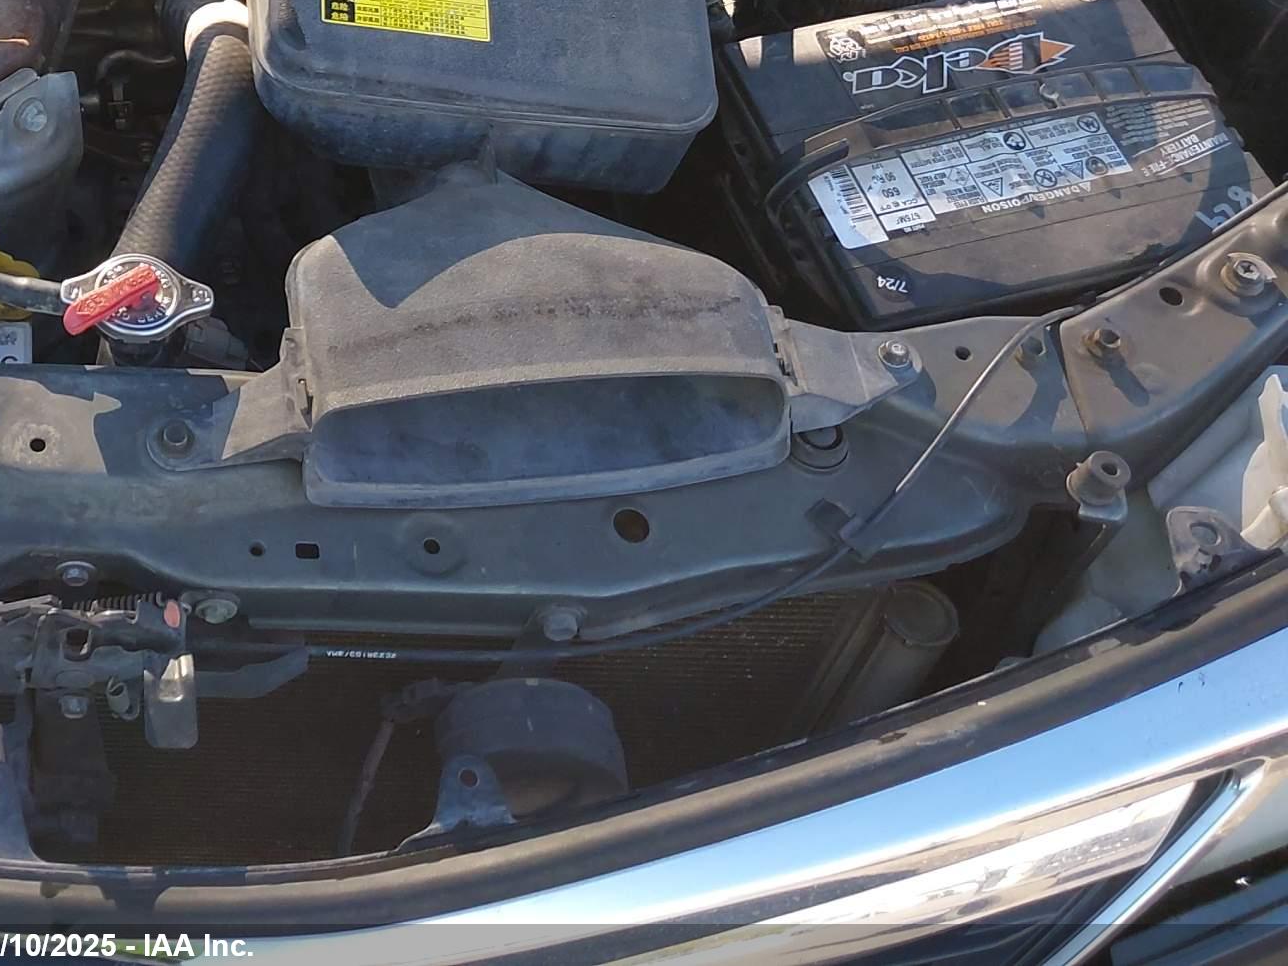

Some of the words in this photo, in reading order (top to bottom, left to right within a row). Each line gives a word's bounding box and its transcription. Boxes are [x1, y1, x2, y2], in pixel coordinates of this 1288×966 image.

[1158, 133, 1199, 156] BATTERY
[881, 187, 901, 199] 650
[902, 198, 918, 206] CCA
[877, 276, 908, 292] 7/24
